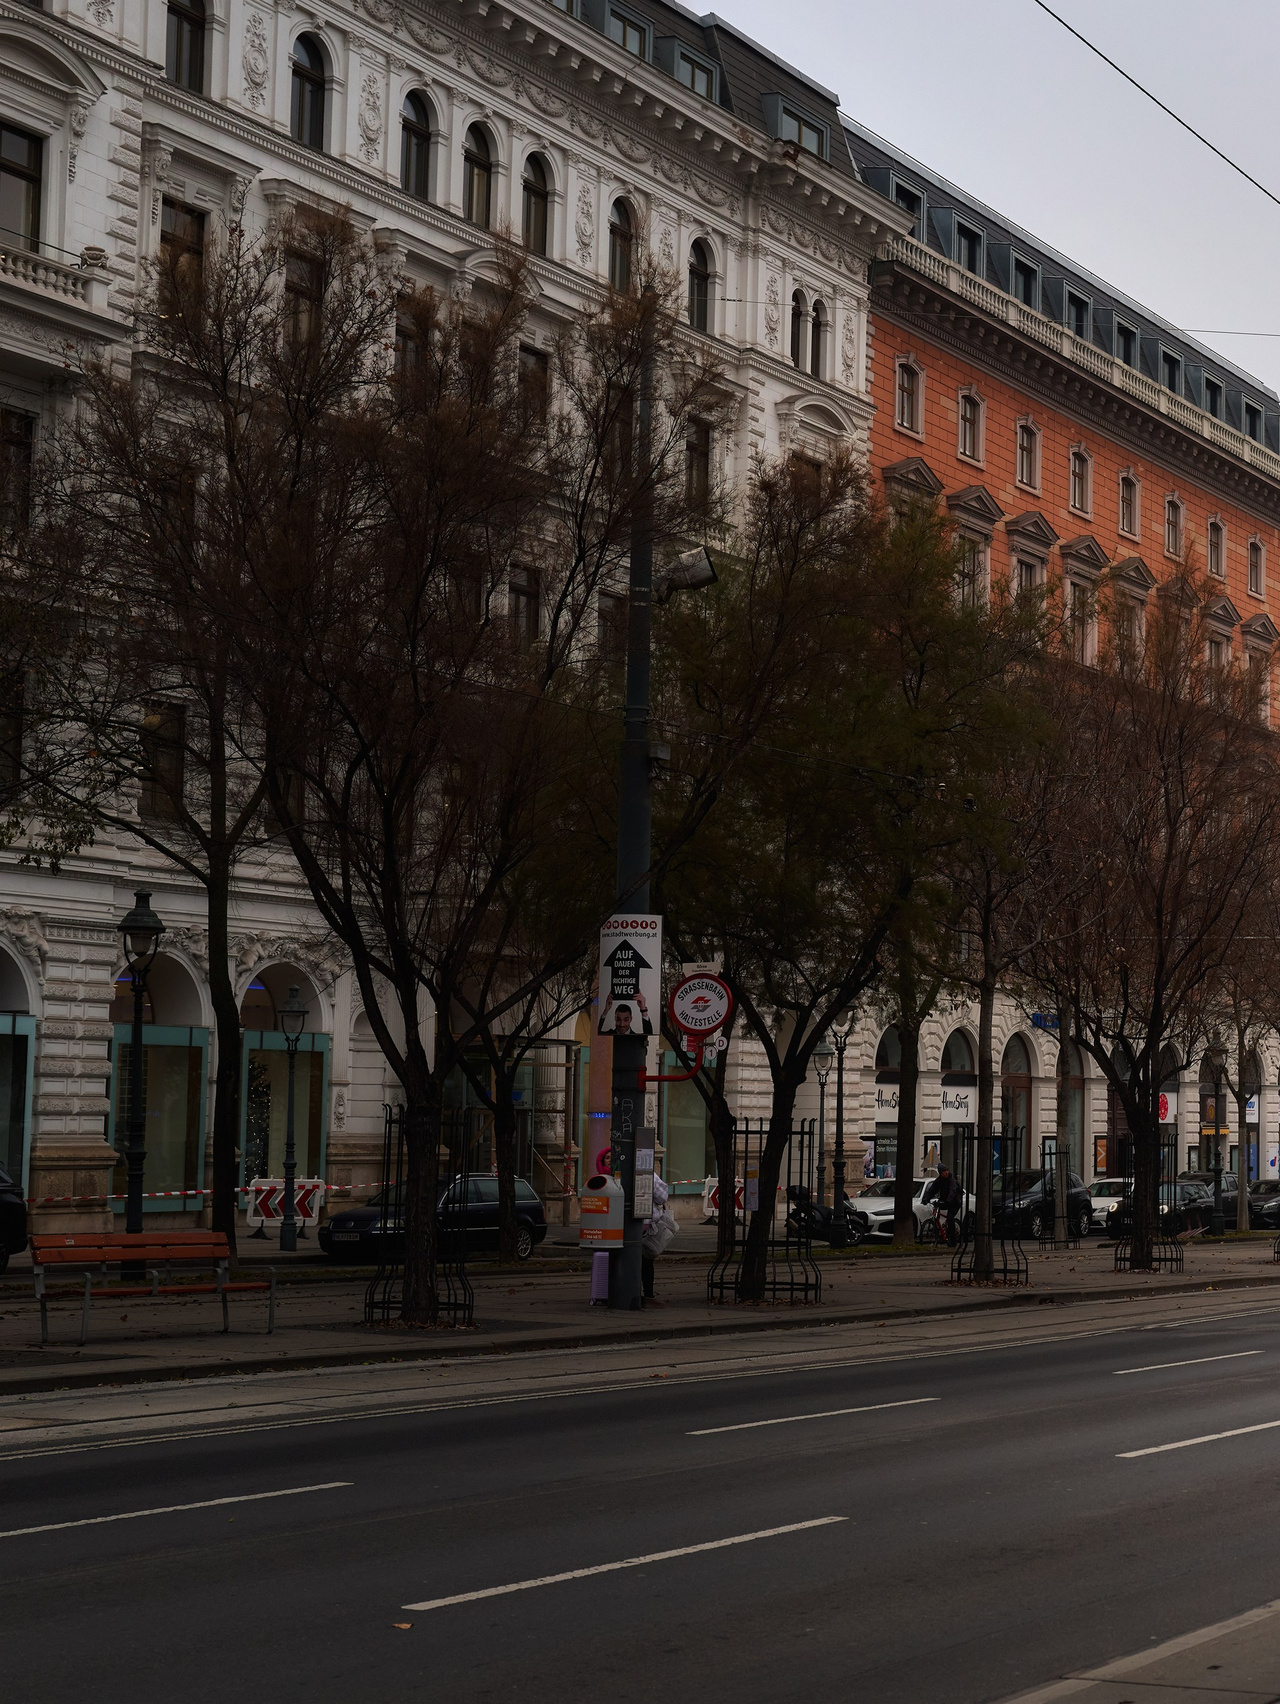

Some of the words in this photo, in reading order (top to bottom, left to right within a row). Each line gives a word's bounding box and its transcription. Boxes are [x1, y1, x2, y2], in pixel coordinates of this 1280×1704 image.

[616, 951, 634, 959] AUF
[614, 986, 635, 995] WEG
[677, 981, 725, 1002] STRASSENBAHN
[678, 1009, 723, 1027] HALTESTELLE
[718, 1039, 725, 1047] D
[709, 1049, 713, 1057] 1
